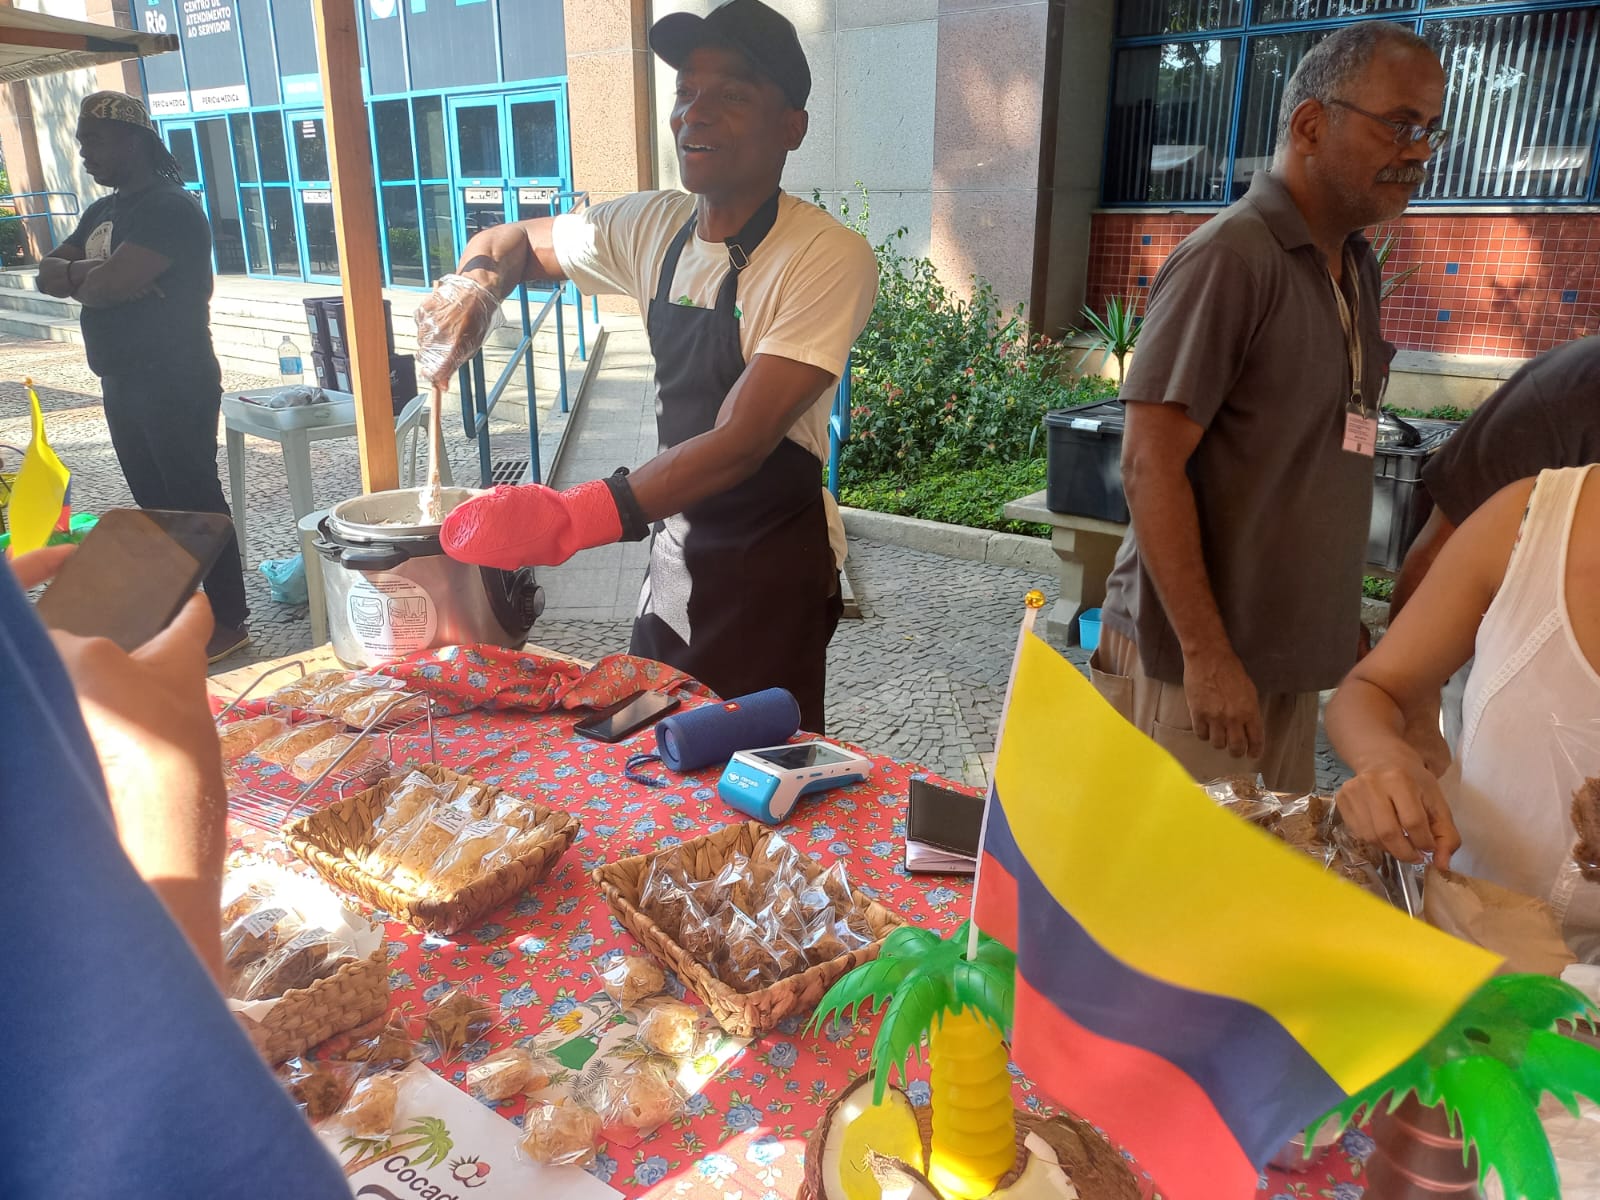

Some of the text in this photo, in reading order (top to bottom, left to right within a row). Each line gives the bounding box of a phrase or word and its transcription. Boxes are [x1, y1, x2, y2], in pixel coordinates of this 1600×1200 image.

[184, 0, 209, 13] CENTRO
[146, 10, 167, 33] Rio
[186, 7, 231, 26] ATENDIMENTO
[188, 21, 231, 38] AO SERVIDOR
